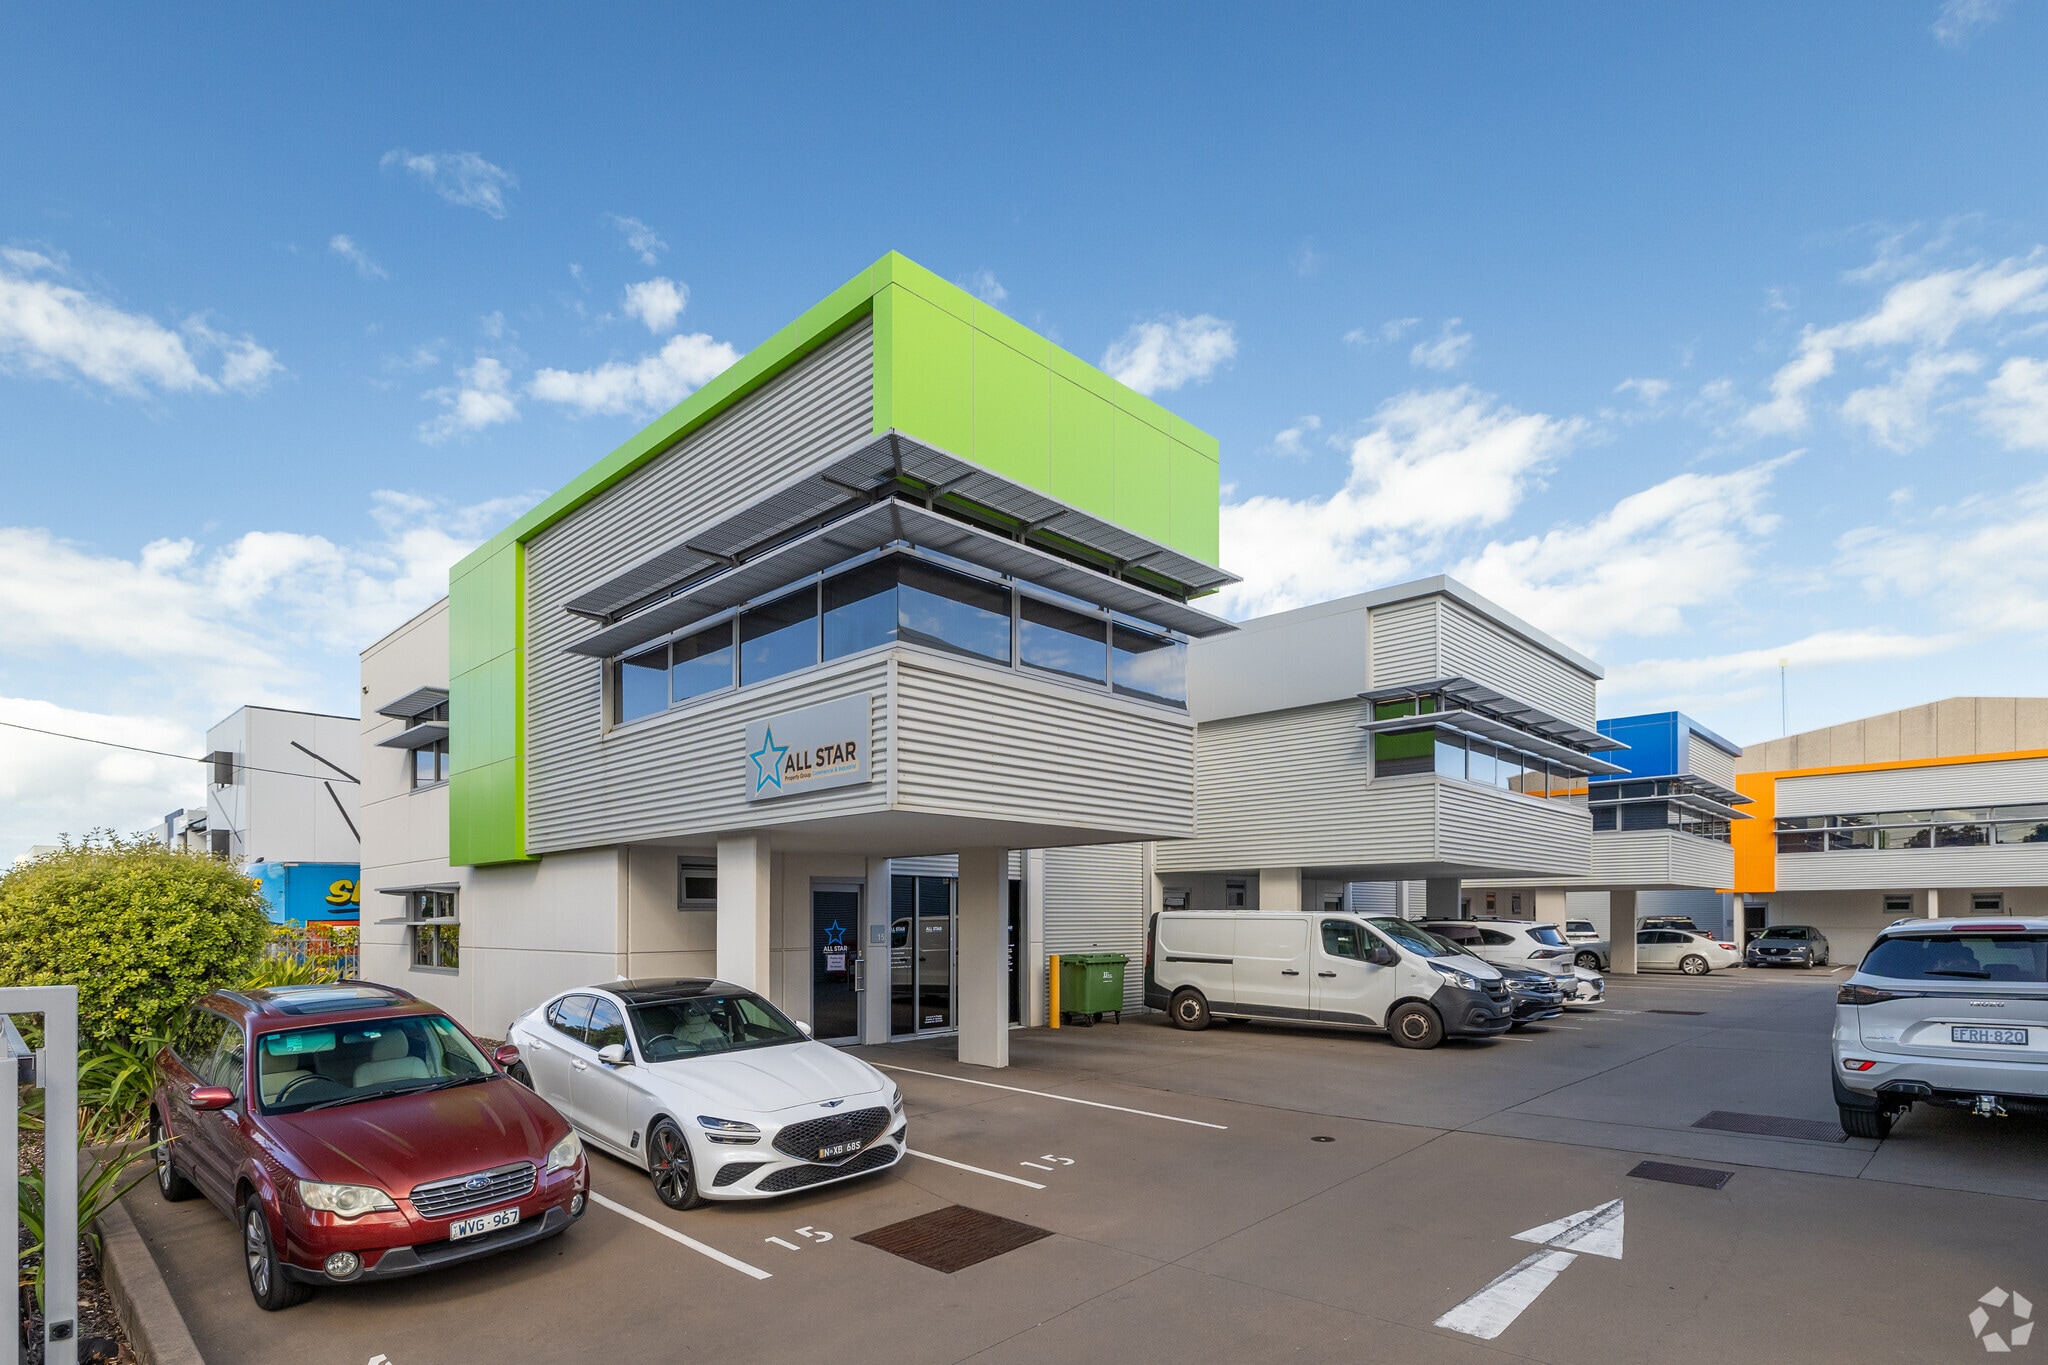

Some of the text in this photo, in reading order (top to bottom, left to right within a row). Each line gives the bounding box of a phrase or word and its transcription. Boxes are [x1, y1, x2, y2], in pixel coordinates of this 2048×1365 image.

[785, 741, 856, 774] ALL STAR
[878, 933, 885, 941] 15
[1020, 1154, 1075, 1171] 15
[764, 1225, 834, 1251] 15
